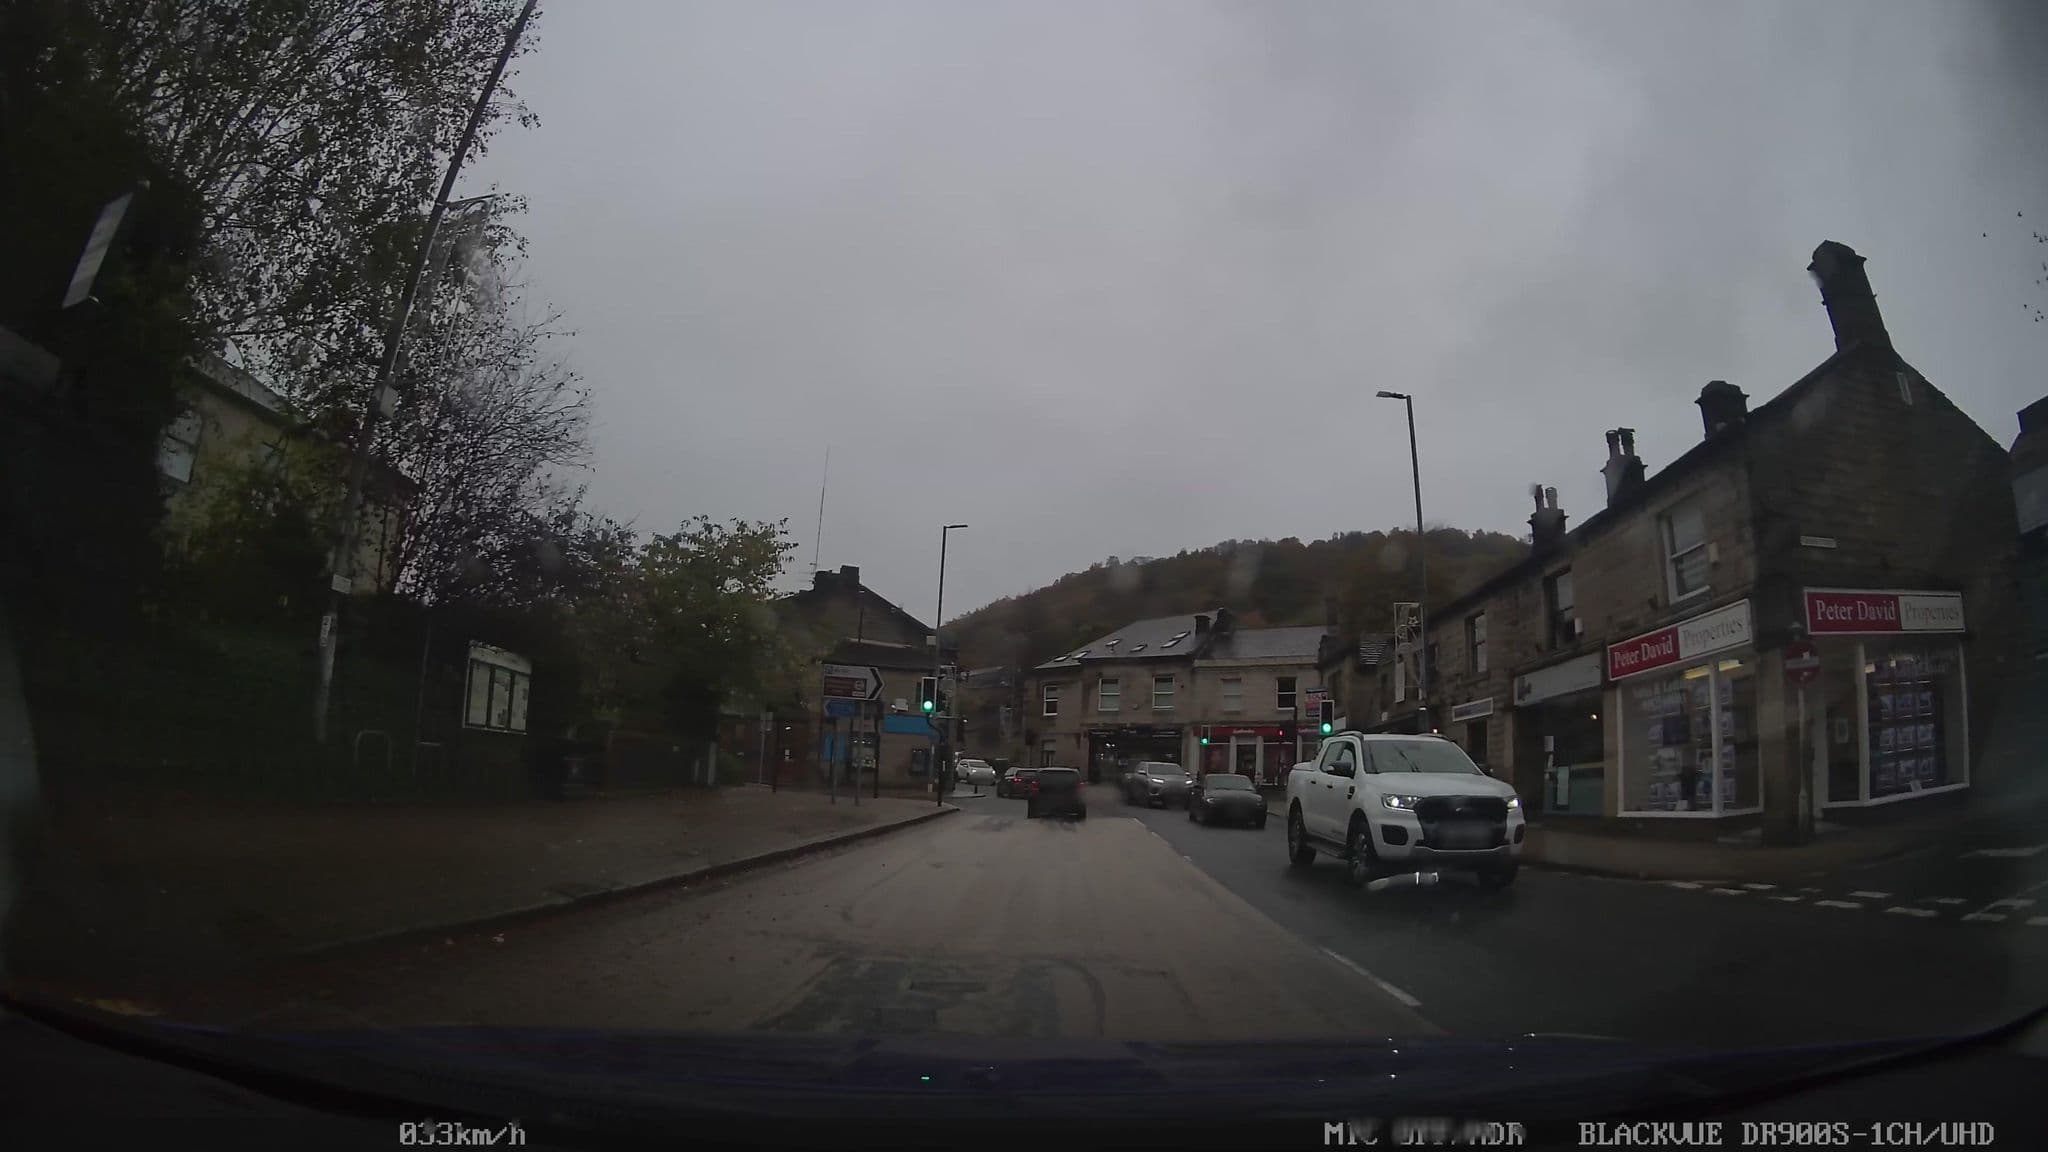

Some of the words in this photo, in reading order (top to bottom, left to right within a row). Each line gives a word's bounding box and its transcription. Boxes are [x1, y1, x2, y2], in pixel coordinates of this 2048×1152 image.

[1816, 600, 1853, 621] Peter
[1857, 600, 1896, 621] David
[1904, 601, 1960, 625] Properties
[1615, 650, 1639, 669] Peter
[1641, 634, 1673, 660] David
[1682, 615, 1744, 648] Properties
